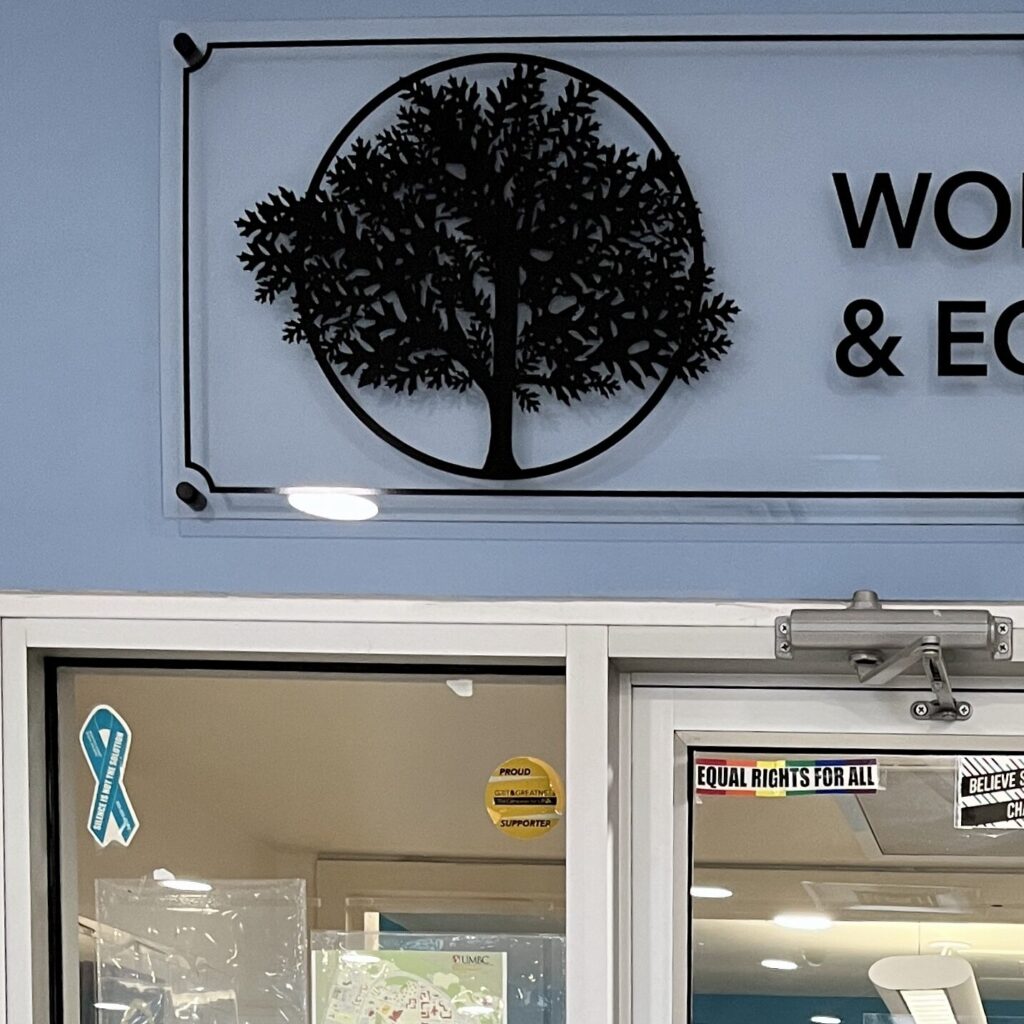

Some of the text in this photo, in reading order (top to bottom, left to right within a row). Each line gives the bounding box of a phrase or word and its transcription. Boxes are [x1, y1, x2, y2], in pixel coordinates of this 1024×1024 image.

[835, 298, 904, 377] &
[499, 768, 531, 776] PROUD
[697, 765, 875, 790] EQUAL RIGHTS FOR ALL
[969, 772, 1016, 794] BELIEVE
[500, 819, 551, 827] SUPPORTER
[461, 955, 489, 965] UMBC
